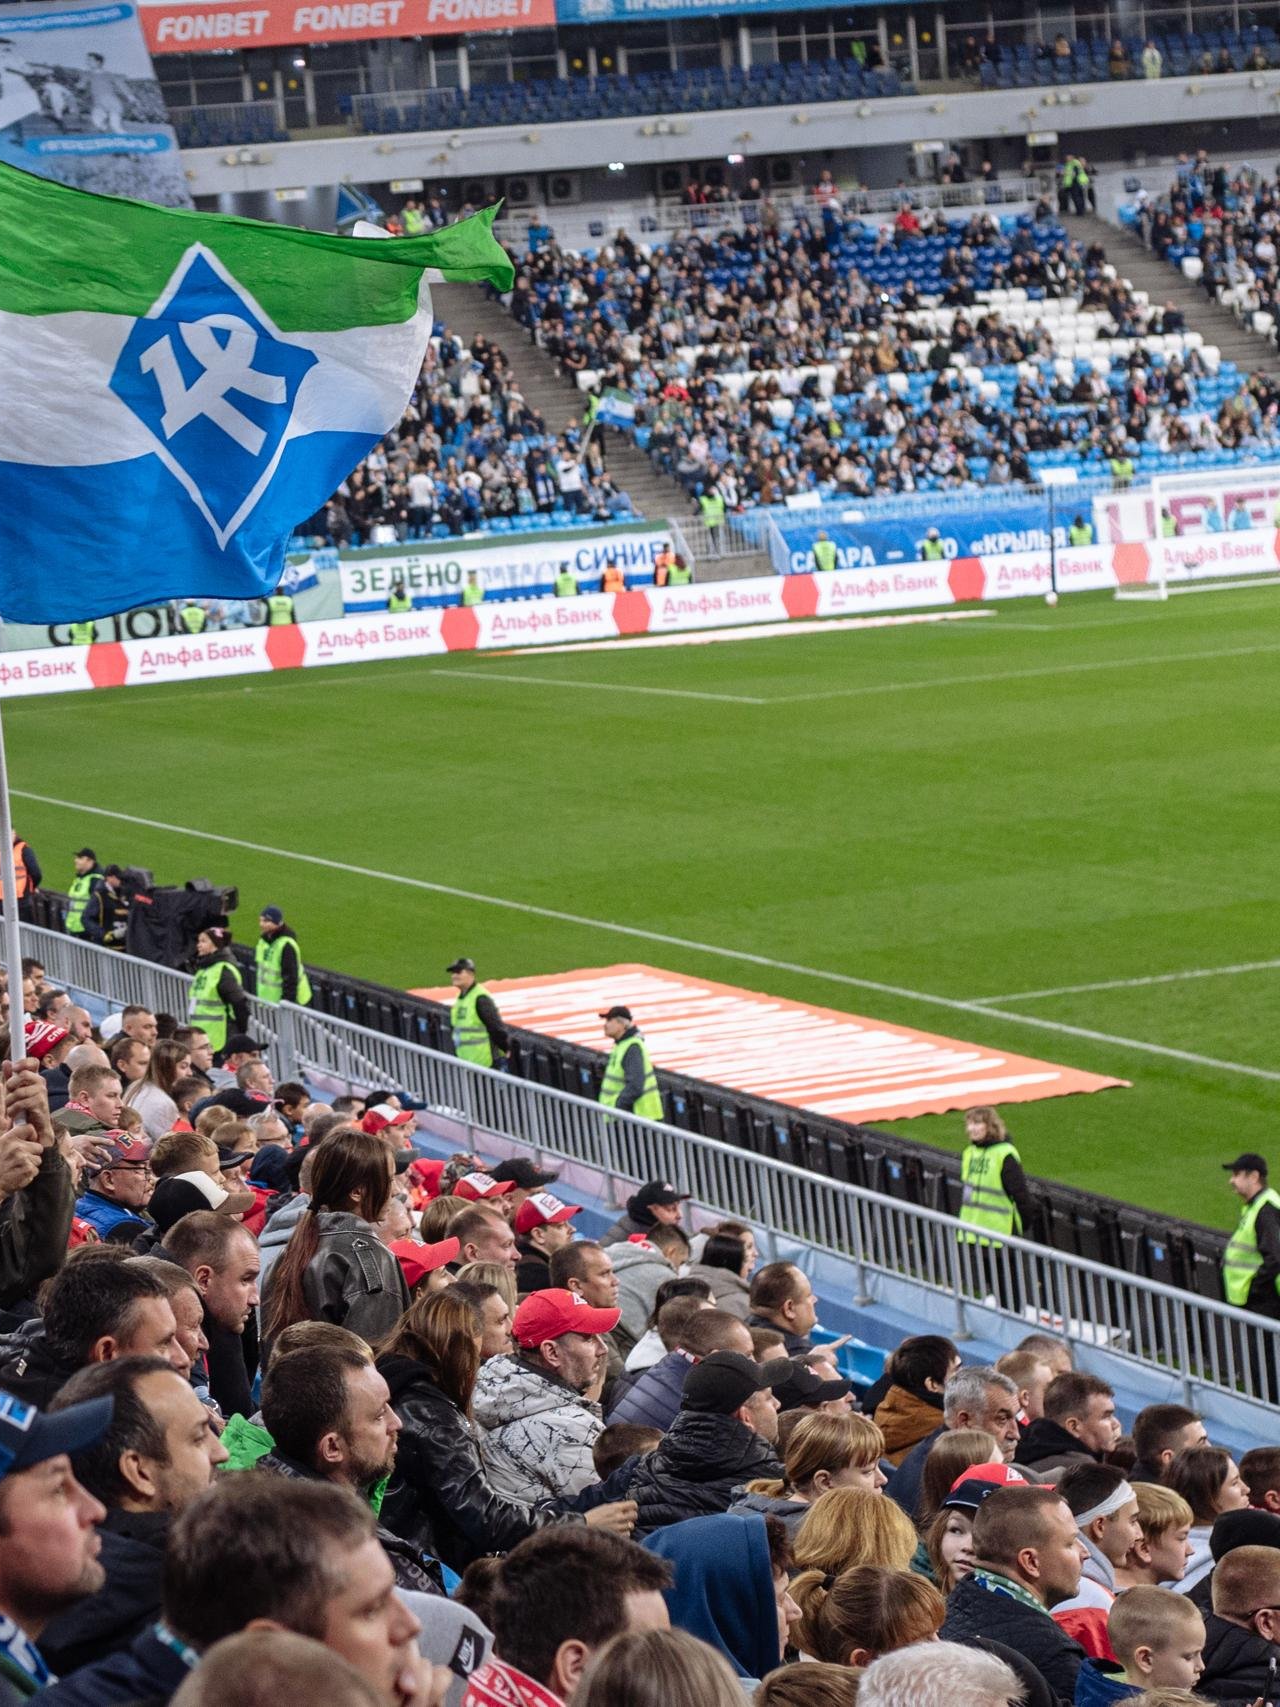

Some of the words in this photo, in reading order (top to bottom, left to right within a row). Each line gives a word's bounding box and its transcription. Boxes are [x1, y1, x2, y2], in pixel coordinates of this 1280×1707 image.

[157, 10, 270, 42] FONBET
[293, 1, 405, 32] FONBET
[792, 546, 875, 573] СААРА
[1059, 556, 1103, 576] Банк
[831, 579, 889, 599] Альфа
[894, 574, 938, 592] Банк
[662, 596, 723, 615] Альфа
[726, 591, 772, 608] Банк
[492, 613, 553, 632] Альфа
[556, 608, 602, 625] Банк
[318, 629, 380, 648] Альфа
[383, 624, 431, 642] Банк
[140, 646, 204, 668] Альфа
[208, 642, 256, 661] Банк
[28, 659, 76, 677] Банк
